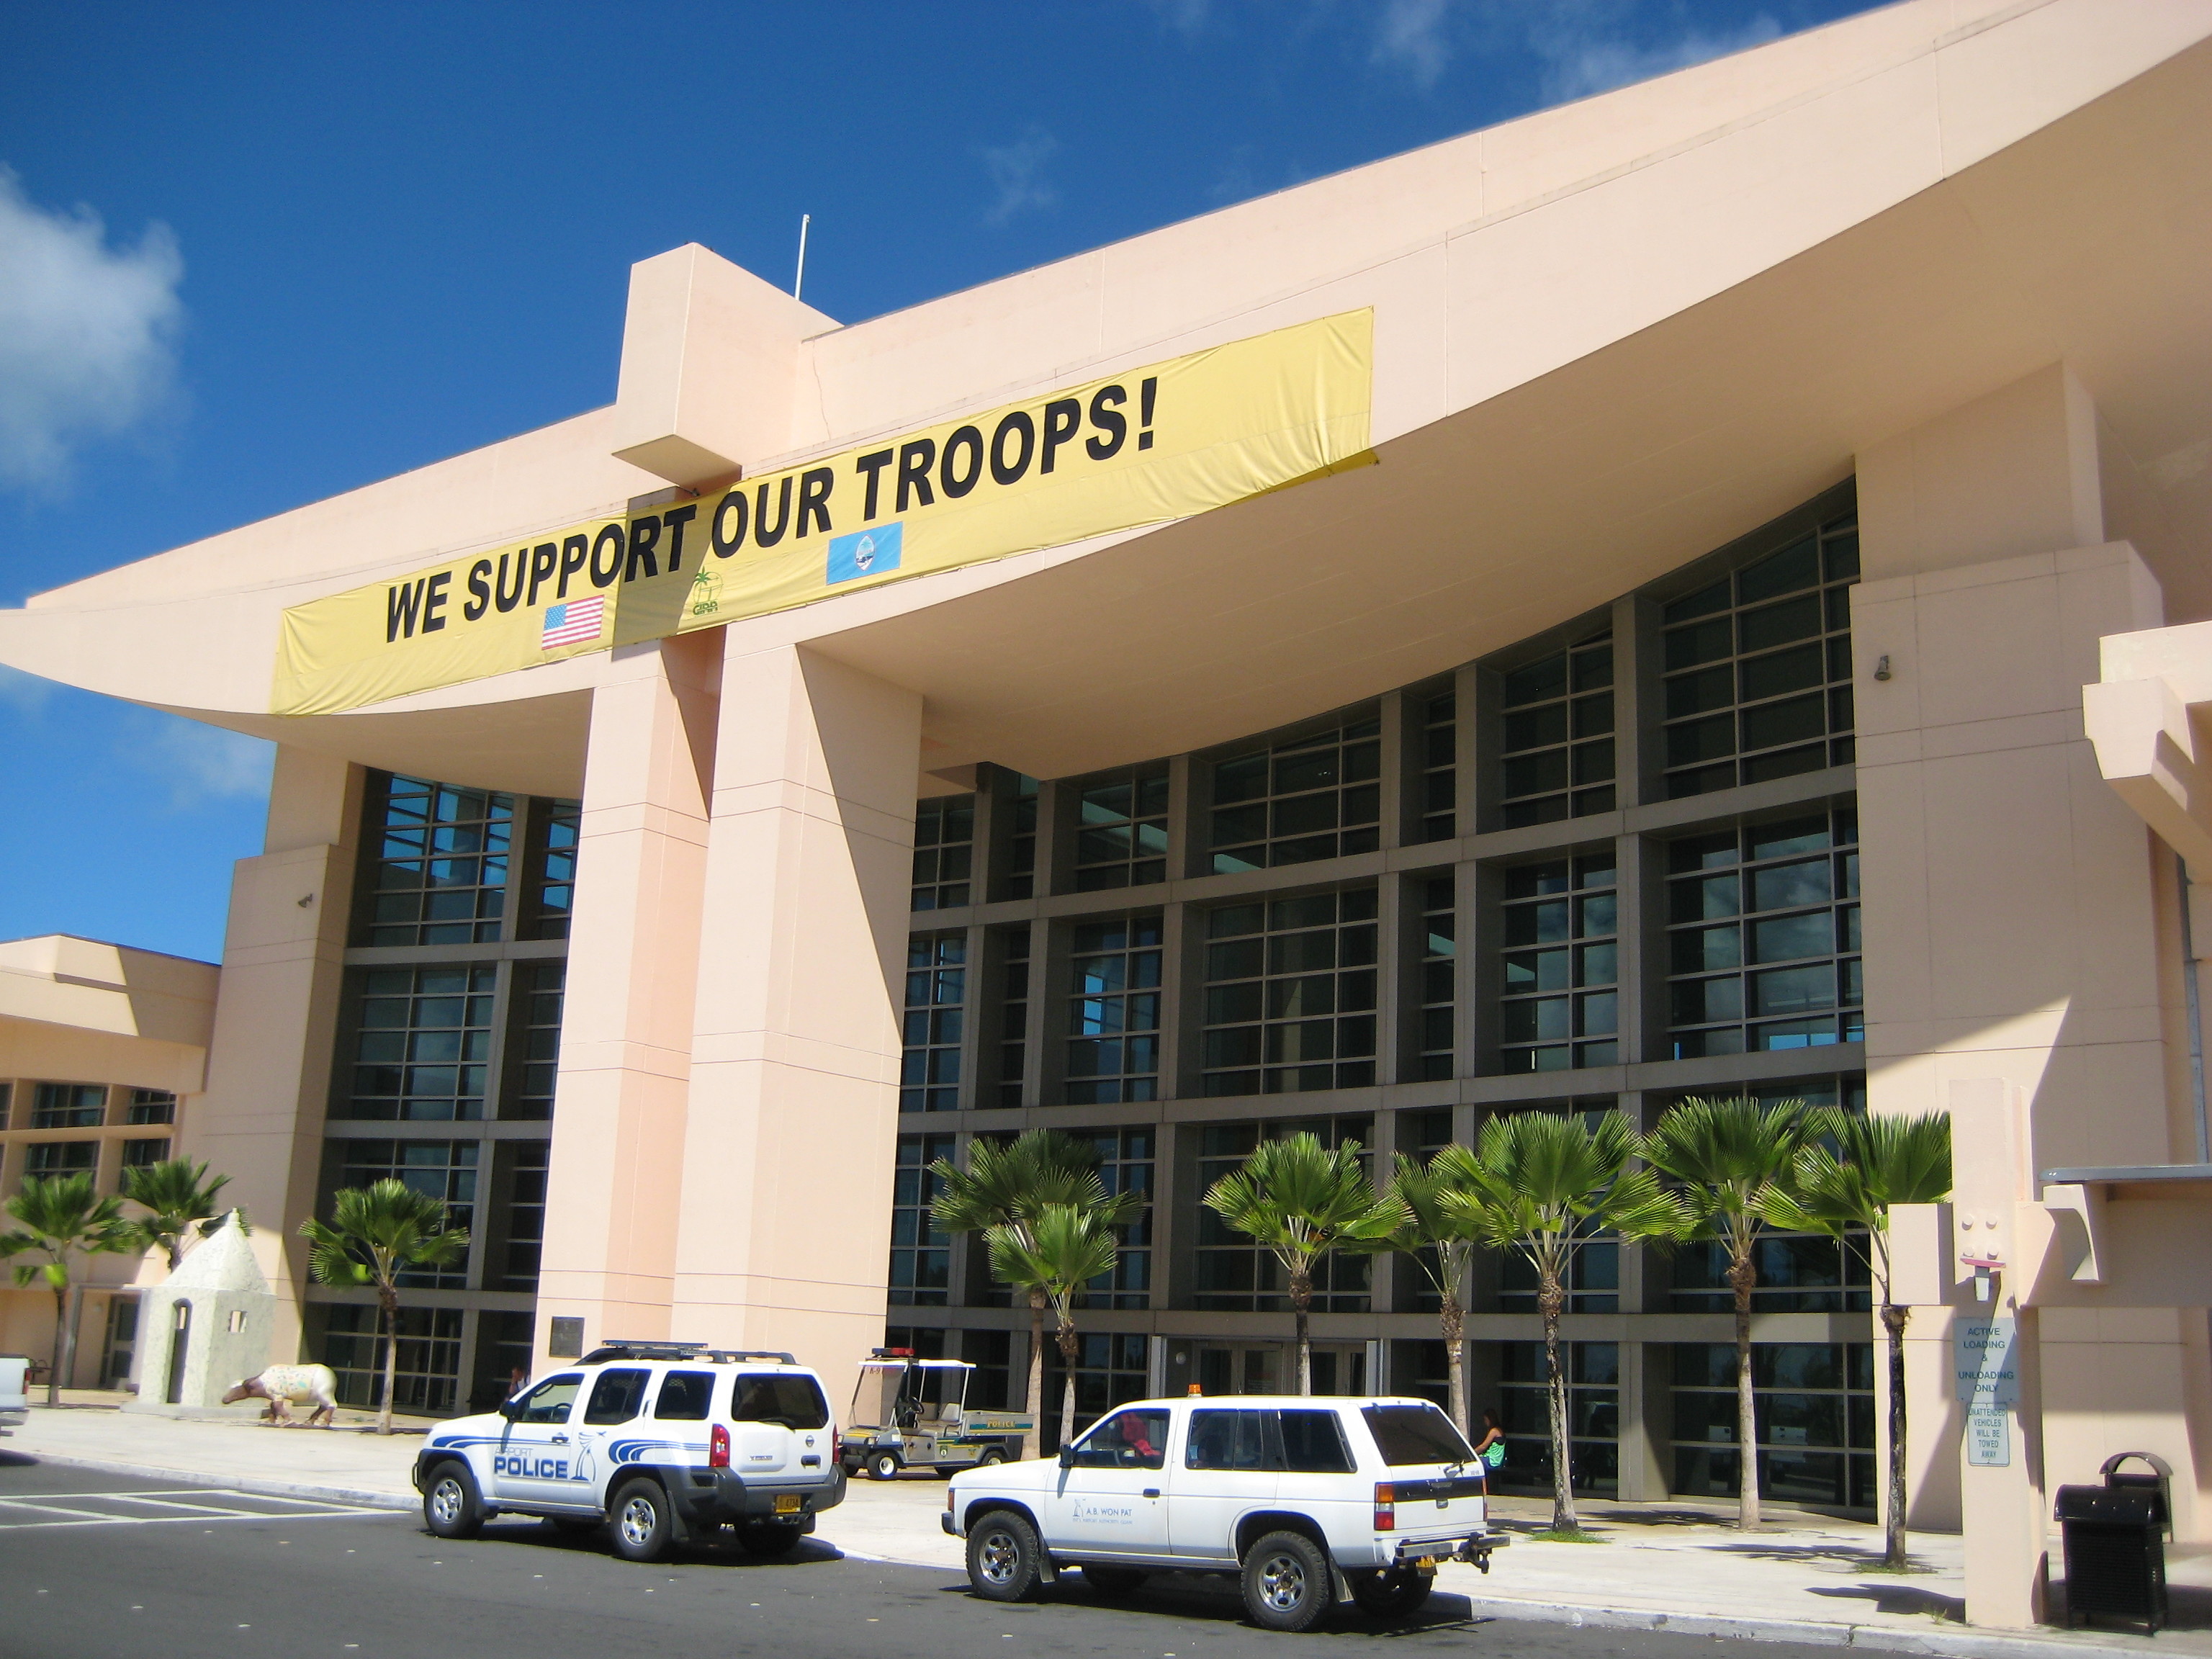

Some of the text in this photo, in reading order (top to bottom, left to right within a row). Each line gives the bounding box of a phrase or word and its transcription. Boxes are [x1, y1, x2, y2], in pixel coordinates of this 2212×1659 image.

[387, 377, 1157, 643] WE SUPPORT OUR TROOPS!
[1967, 1327, 2000, 1336] ACTIVE
[1958, 1371, 2014, 1380] UNLOADING
[1974, 1384, 1998, 1393] ONLY
[1974, 1419, 2002, 1427] VEHICLES
[1978, 1439, 1999, 1448] TOWED
[1982, 1449, 1997, 1458] AWAY
[494, 1456, 568, 1479] POLICE
[1101, 1508, 1119, 1516] WON
